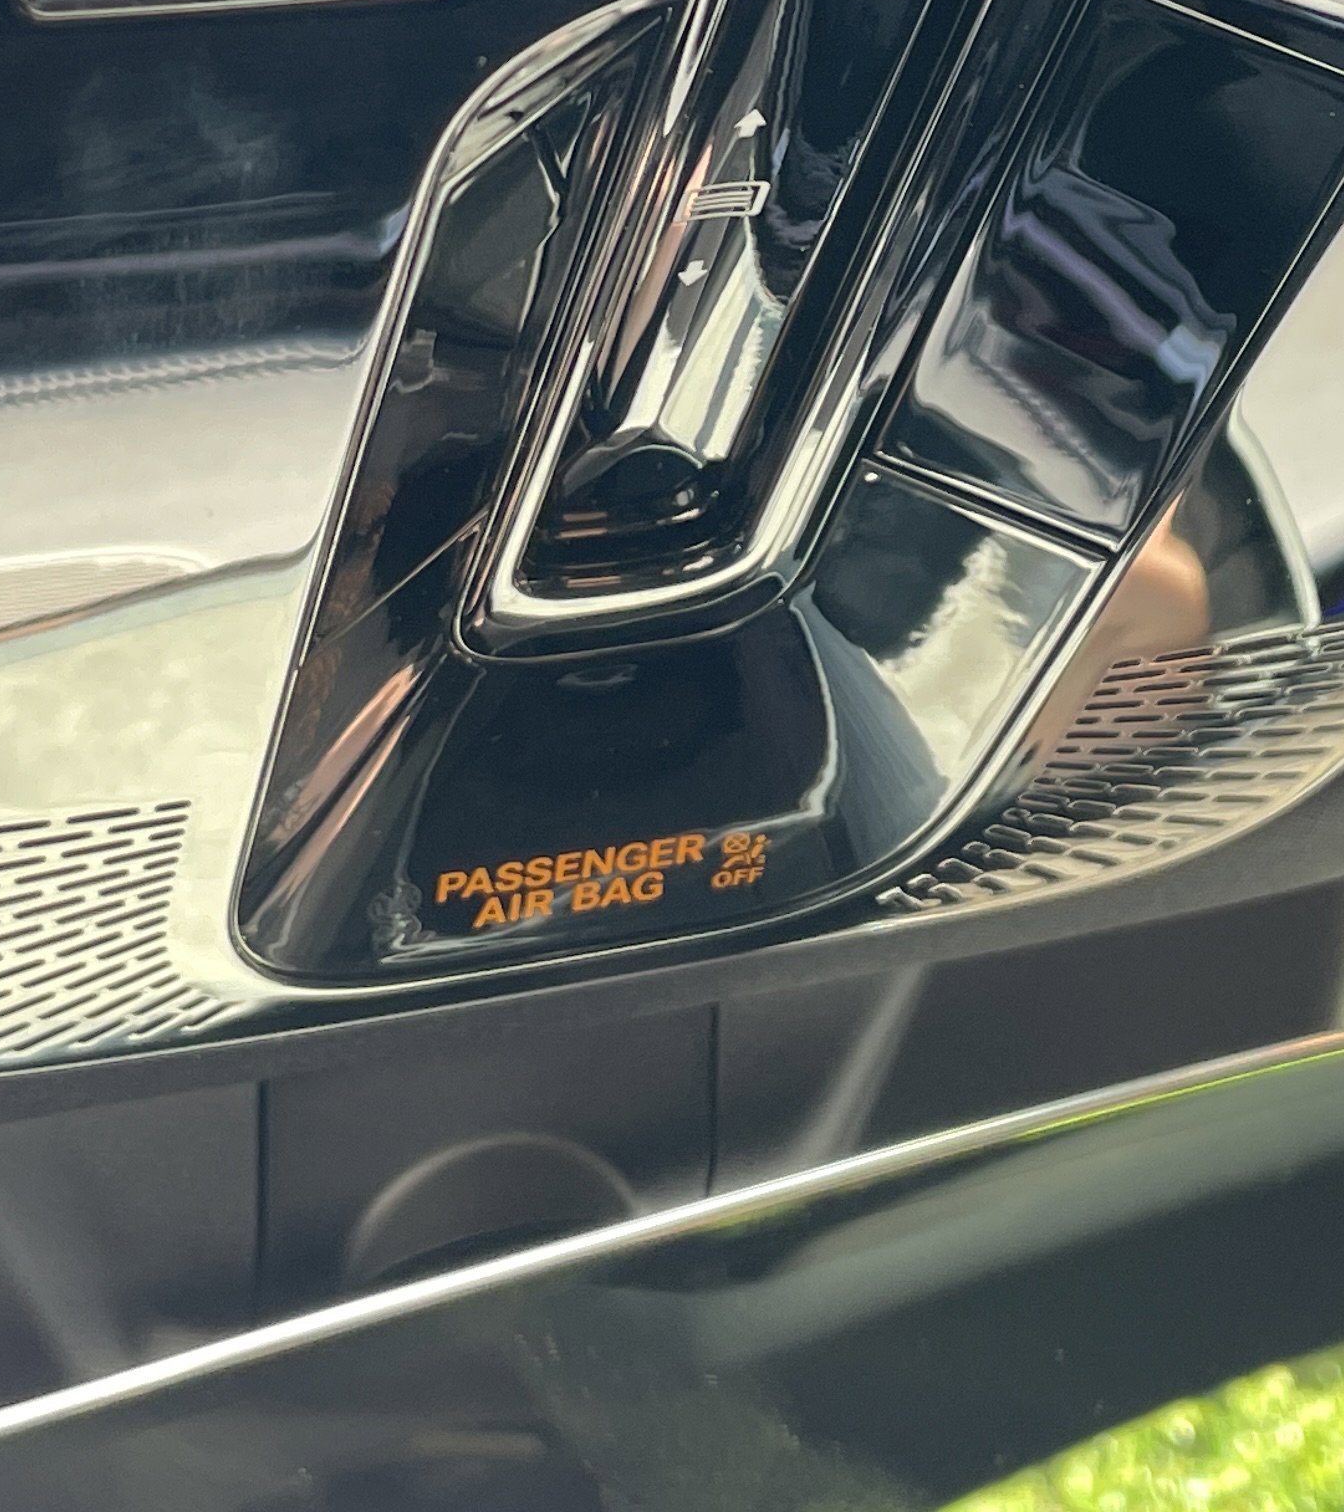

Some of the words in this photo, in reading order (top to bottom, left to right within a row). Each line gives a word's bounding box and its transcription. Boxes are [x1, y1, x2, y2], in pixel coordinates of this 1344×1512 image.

[435, 833, 707, 903] PASSENGER
[710, 866, 765, 890] OFF
[471, 891, 555, 930] AIR
[570, 871, 665, 914] BAG
